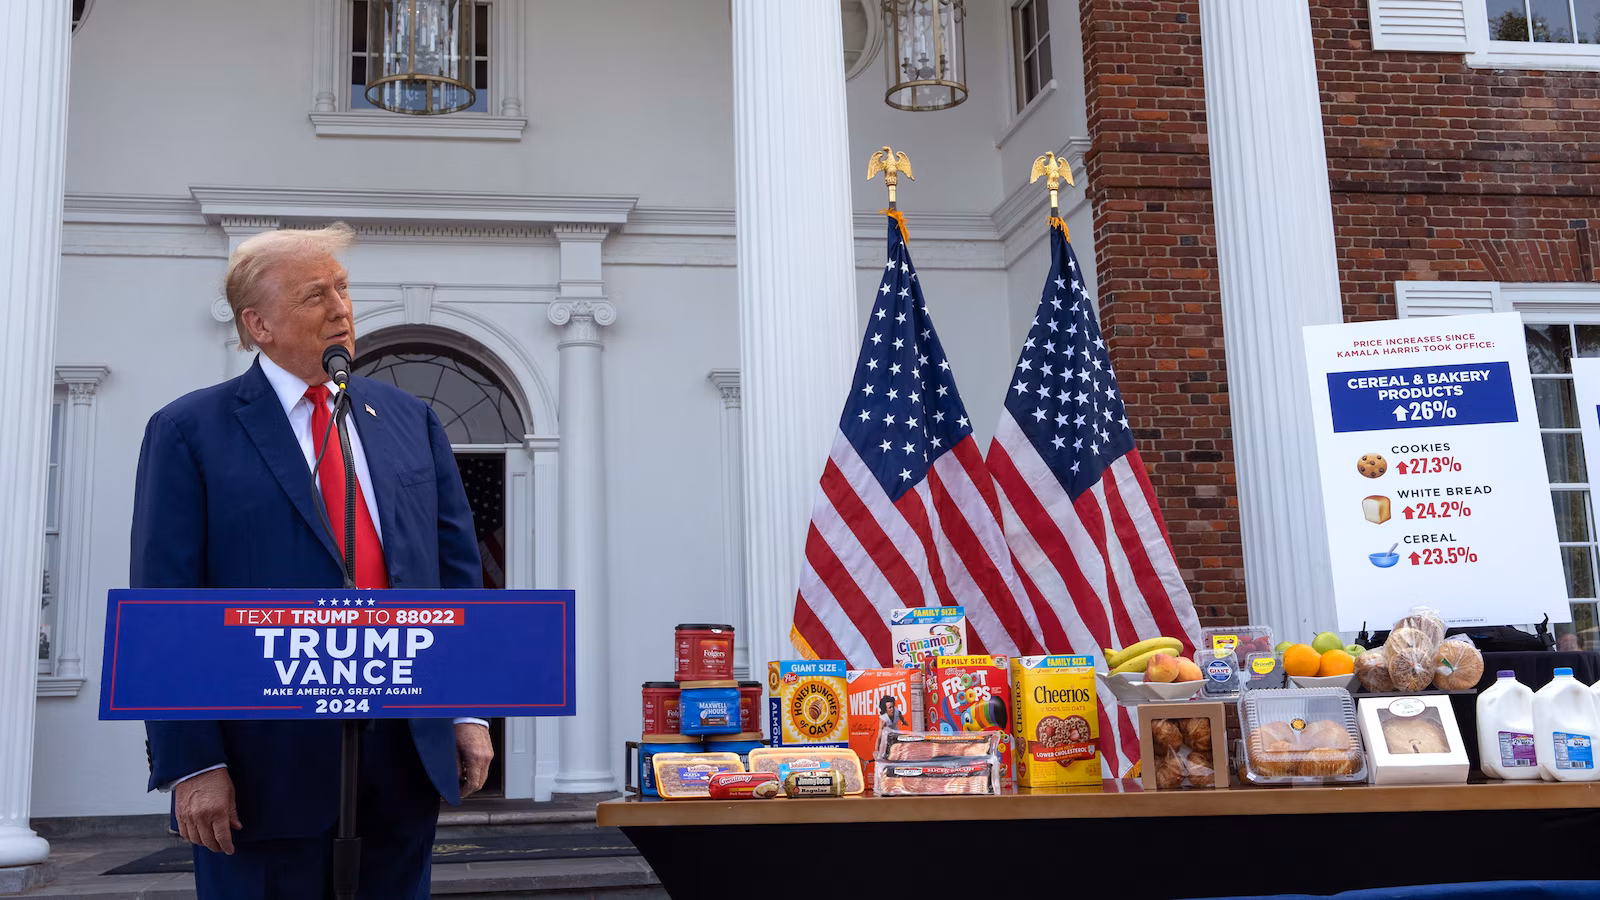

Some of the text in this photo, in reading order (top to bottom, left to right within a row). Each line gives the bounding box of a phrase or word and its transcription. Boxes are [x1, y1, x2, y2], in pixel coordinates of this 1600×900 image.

[1353, 333, 1476, 348] PRICE INCREASES SINCE
[1336, 341, 1496, 358] KAMALA HARRIS TOOK OFFICE:
[1347, 370, 1491, 390] CEREAL & BAKERY
[1378, 385, 1464, 401] PRODUCTS
[1409, 400, 1457, 421] 26%
[1391, 442, 1451, 454] COOKIES
[1409, 456, 1462, 475] 27.3%
[1397, 485, 1492, 499] WHITE BREAD
[1416, 501, 1472, 520] 24.2%
[1403, 533, 1457, 544] CEREAL
[1422, 546, 1478, 565] 23.5%
[236, 609, 455, 624] TEXT TRUMP TO 88022
[913, 607, 957, 617] FAMILY SIZE
[254, 628, 435, 658] TRUMP
[899, 635, 954, 653] Cinnamon
[703, 649, 725, 658] Folgers
[970, 657, 987, 665] SIZE
[791, 664, 837, 672] GIANT SIZE
[1047, 657, 1087, 666] FAMILY SIZE
[273, 660, 414, 685] VANCE
[942, 670, 988, 697] FROOT
[263, 687, 423, 696] MAKE AMERICA GREAT AGAIN!
[948, 686, 991, 709] LOOPS
[1034, 685, 1090, 704] Cheerios
[315, 699, 370, 714] 2024
[794, 684, 837, 716] HONEY BUNCHES
[808, 720, 833, 735] OATS
[1055, 747, 1087, 756] CHOLESTEROL
